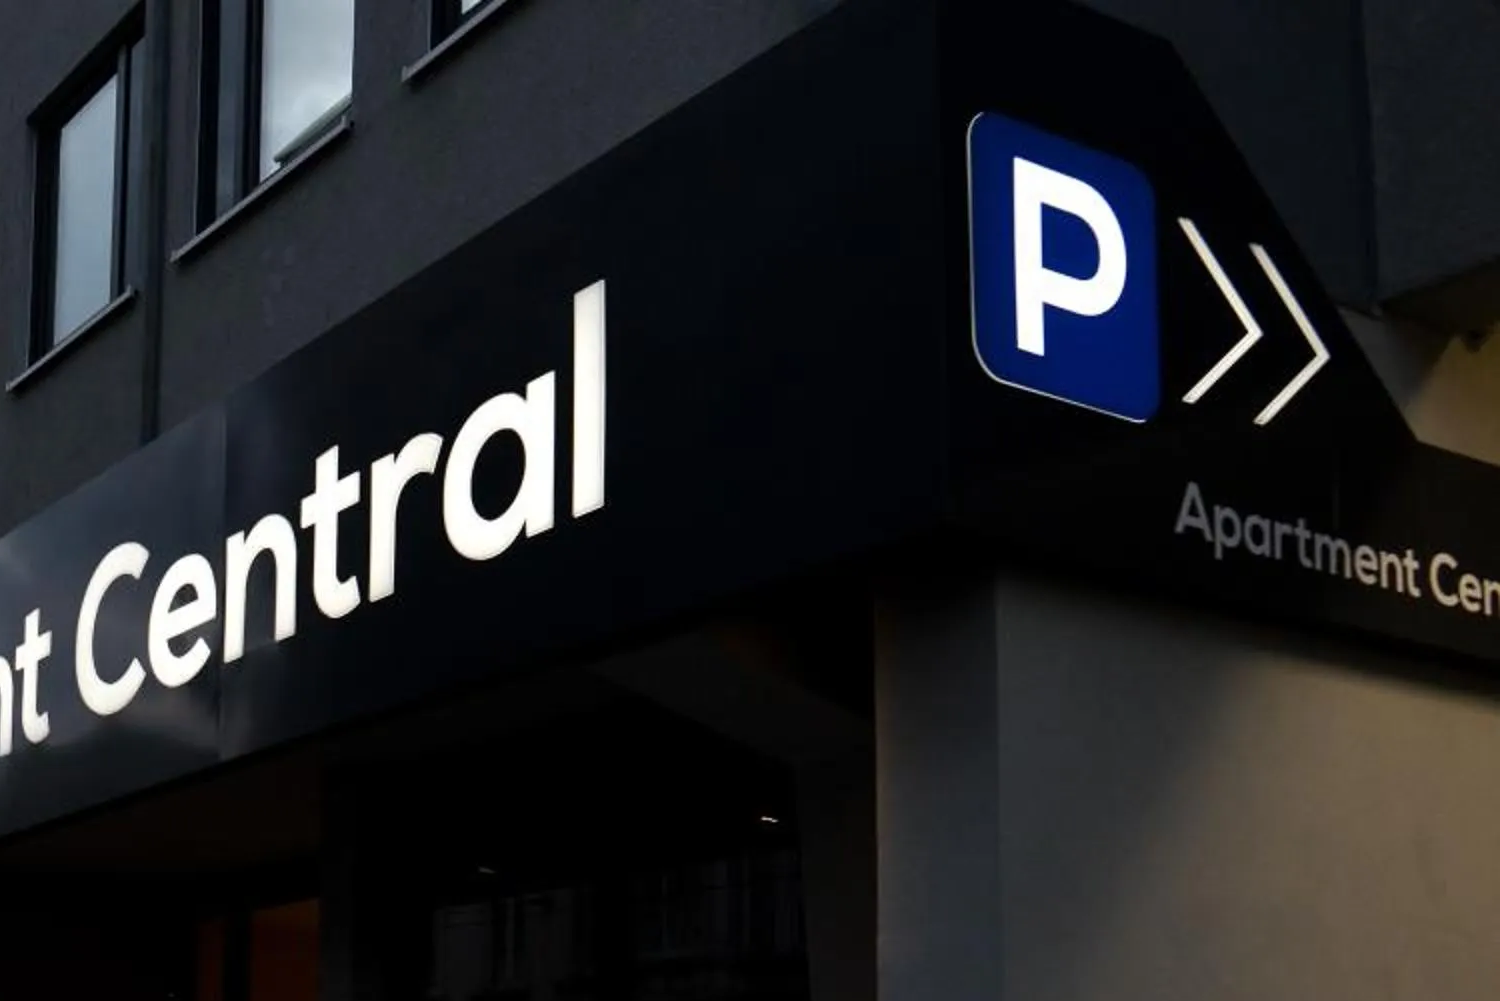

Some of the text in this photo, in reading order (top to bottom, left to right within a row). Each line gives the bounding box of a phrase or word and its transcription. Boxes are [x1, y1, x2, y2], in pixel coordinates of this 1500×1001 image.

[1012, 155, 1128, 358] P
[74, 278, 607, 716] Central
[1173, 480, 1500, 617] Apartment Cen
